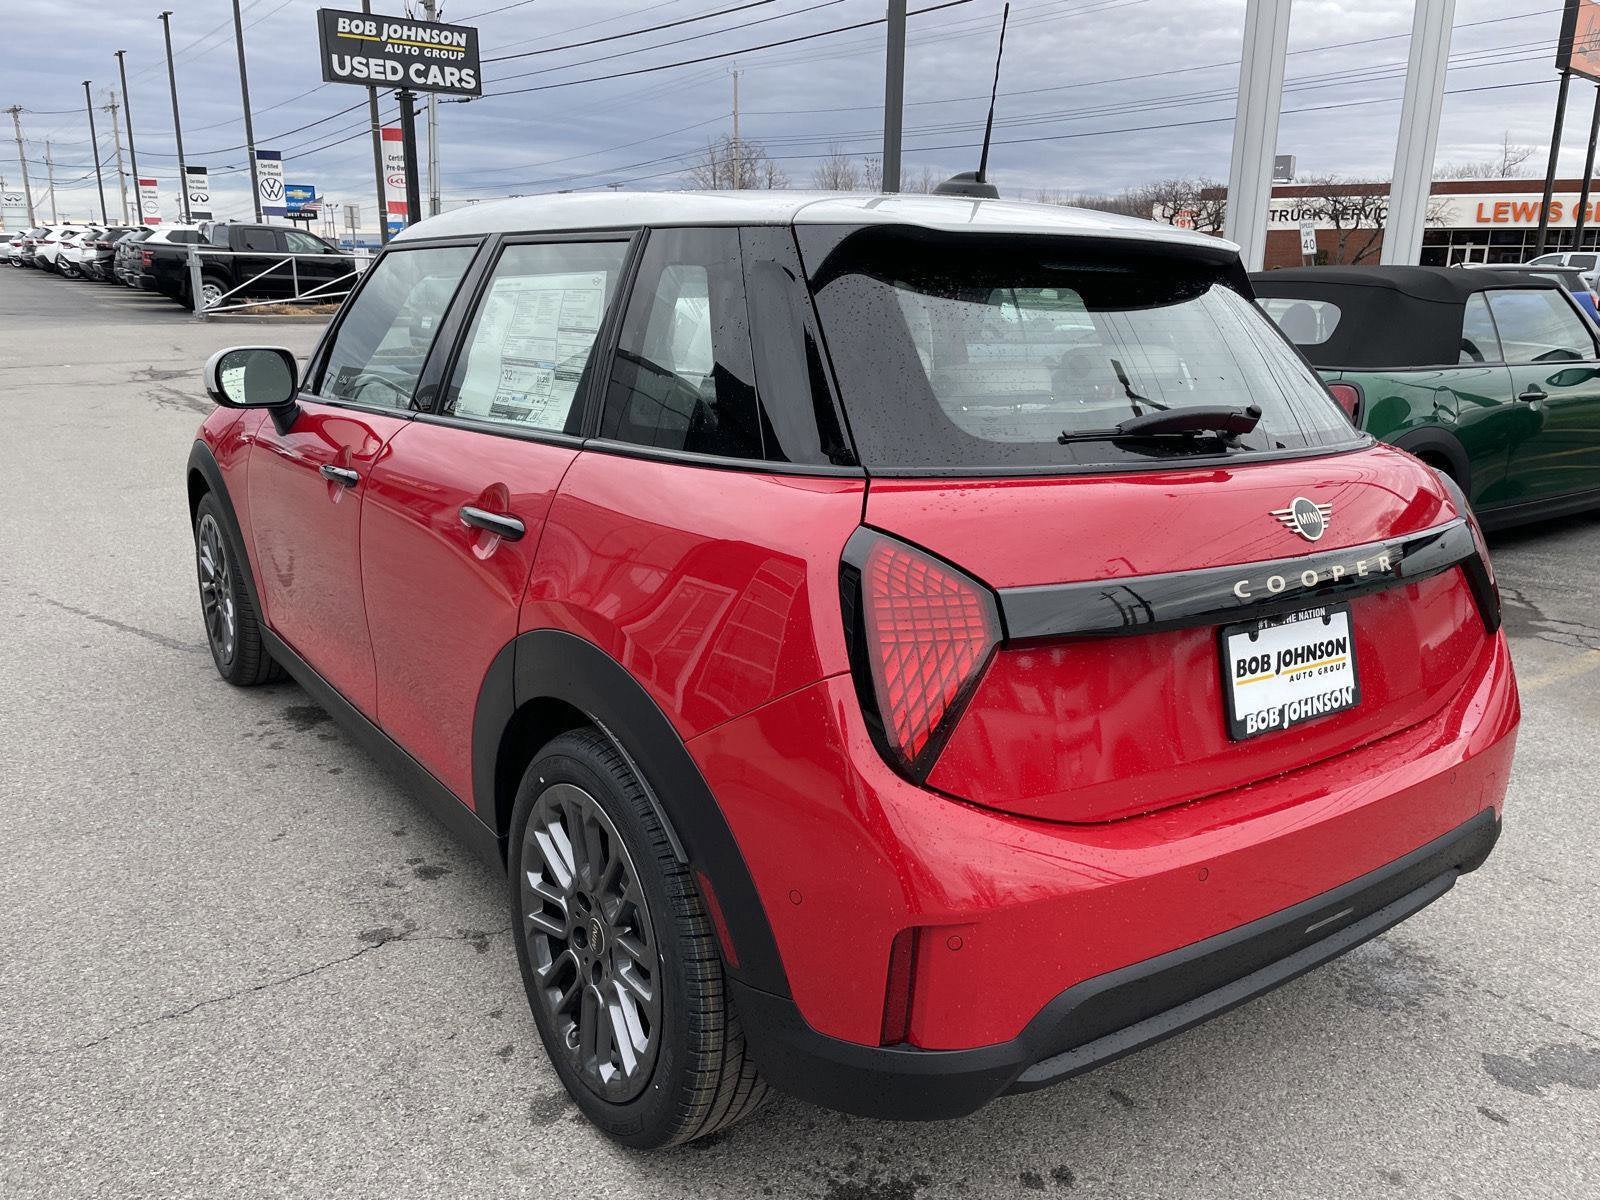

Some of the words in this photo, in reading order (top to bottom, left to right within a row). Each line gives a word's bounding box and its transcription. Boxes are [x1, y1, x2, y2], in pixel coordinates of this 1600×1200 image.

[337, 17, 377, 36] BOB
[380, 23, 467, 47] JOHNSON
[384, 43, 419, 56] AUTO
[423, 48, 465, 61] GROUP
[331, 53, 404, 81] USED
[408, 62, 477, 90] CARS
[1269, 209, 1323, 221] TRUCK
[1303, 239, 1315, 250] 40
[1298, 511, 1321, 525] MINI
[1233, 555, 1392, 598] COOPER
[1298, 607, 1326, 621] NATION
[1236, 653, 1272, 678] BOB
[1275, 637, 1347, 675] JOHNSON
[1289, 670, 1313, 682] AUTO
[1317, 662, 1347, 675] GROUP
[1246, 705, 1280, 734] BOB
[1282, 686, 1353, 729] JOHNSON
